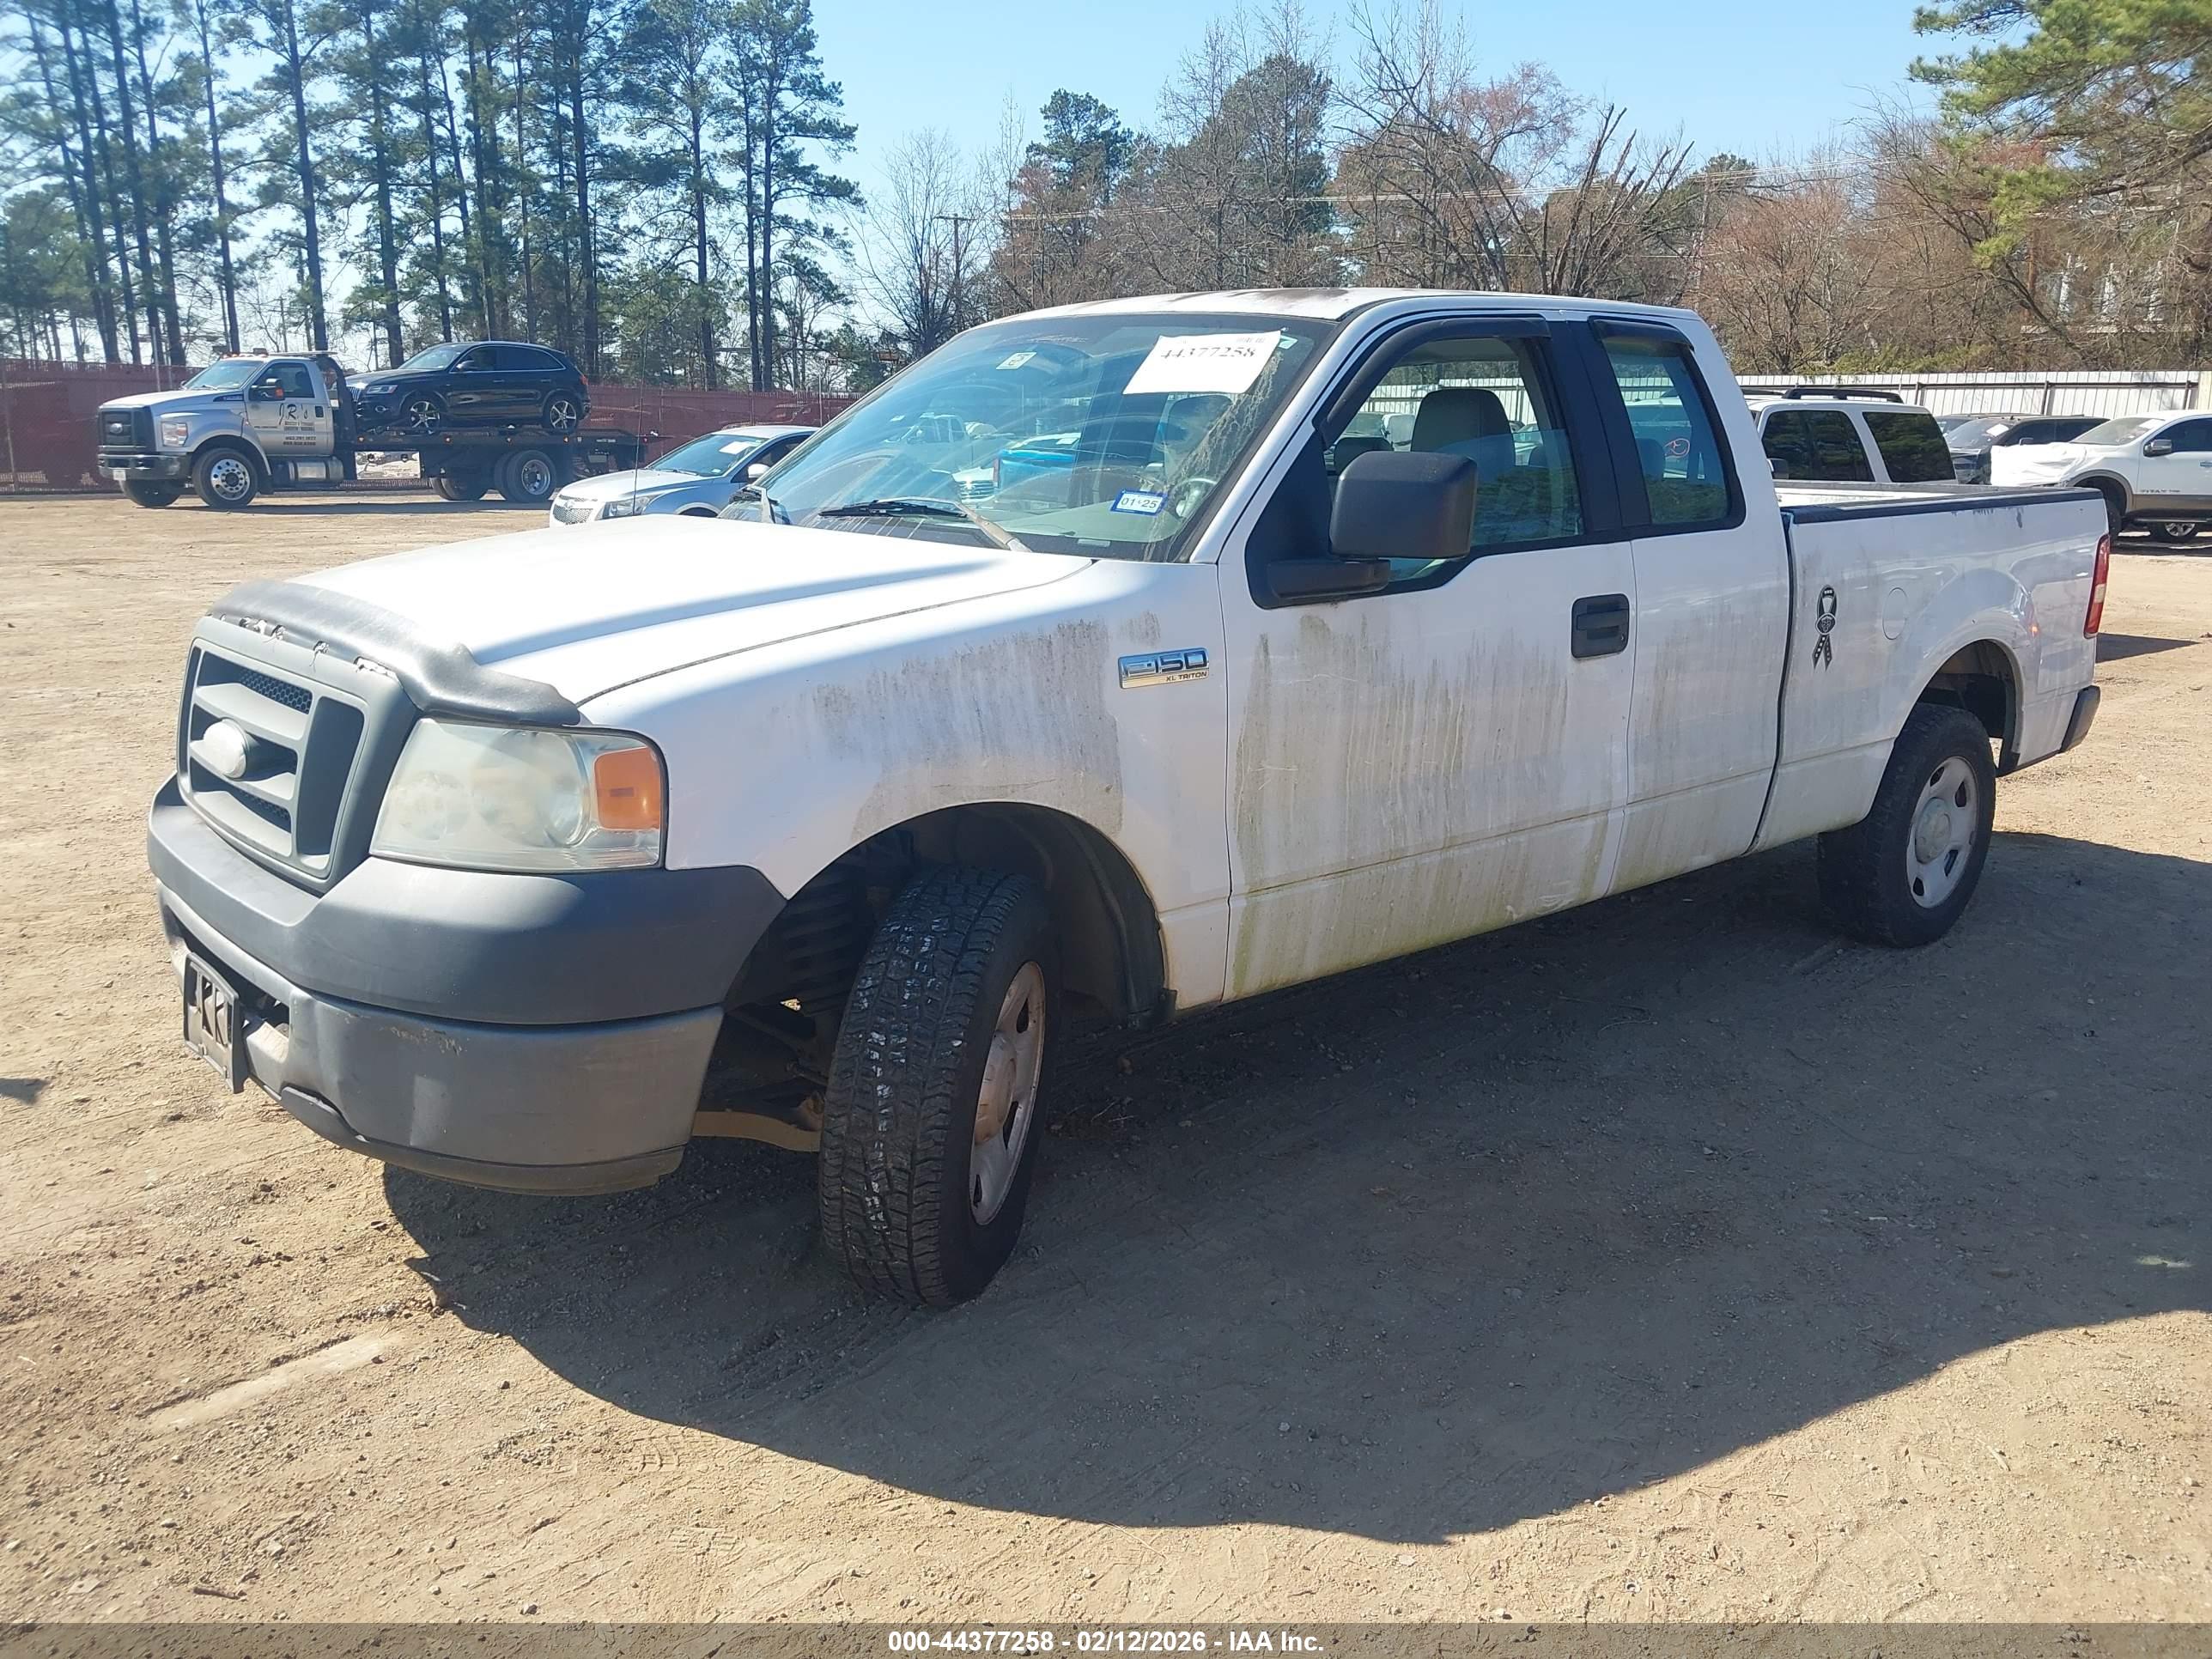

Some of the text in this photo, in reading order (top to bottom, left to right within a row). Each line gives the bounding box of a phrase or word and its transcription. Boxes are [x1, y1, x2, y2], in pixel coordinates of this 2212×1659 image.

[1161, 346, 1255, 359] 44377258
[1165, 671, 1208, 684] XL TRITON
